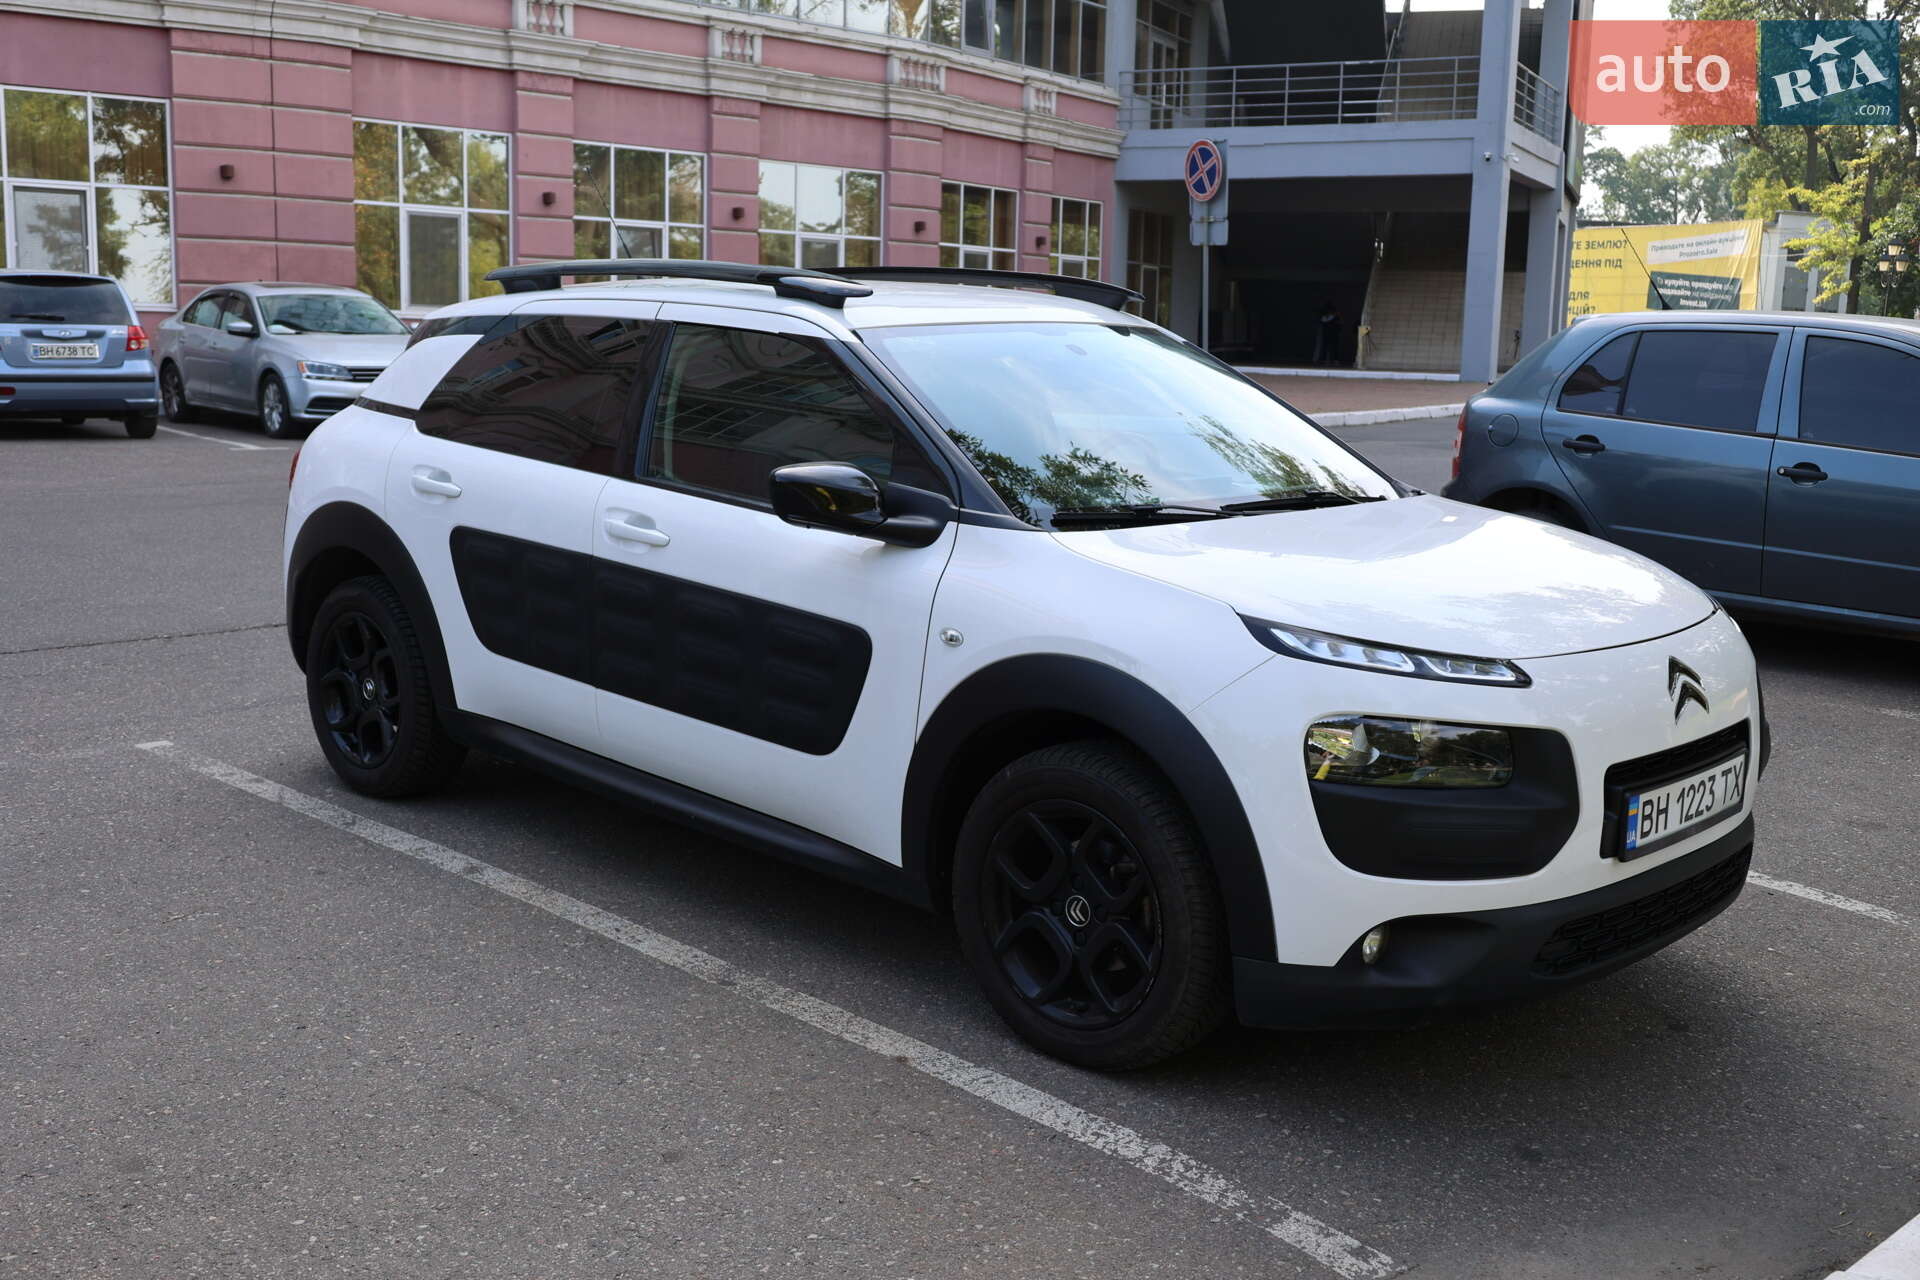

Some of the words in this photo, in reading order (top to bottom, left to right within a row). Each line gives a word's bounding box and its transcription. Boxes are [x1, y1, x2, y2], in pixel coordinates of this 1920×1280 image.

[1585, 240, 1627, 250] ЗЕМЛЮ?
[1604, 259, 1623, 270] ПІД
[40, 346, 54, 356] BH
[56, 346, 78, 356] 6738
[82, 346, 94, 356] TC
[1640, 792, 1670, 840] BH
[1676, 774, 1716, 825] 1223
[1721, 761, 1744, 805] TX
